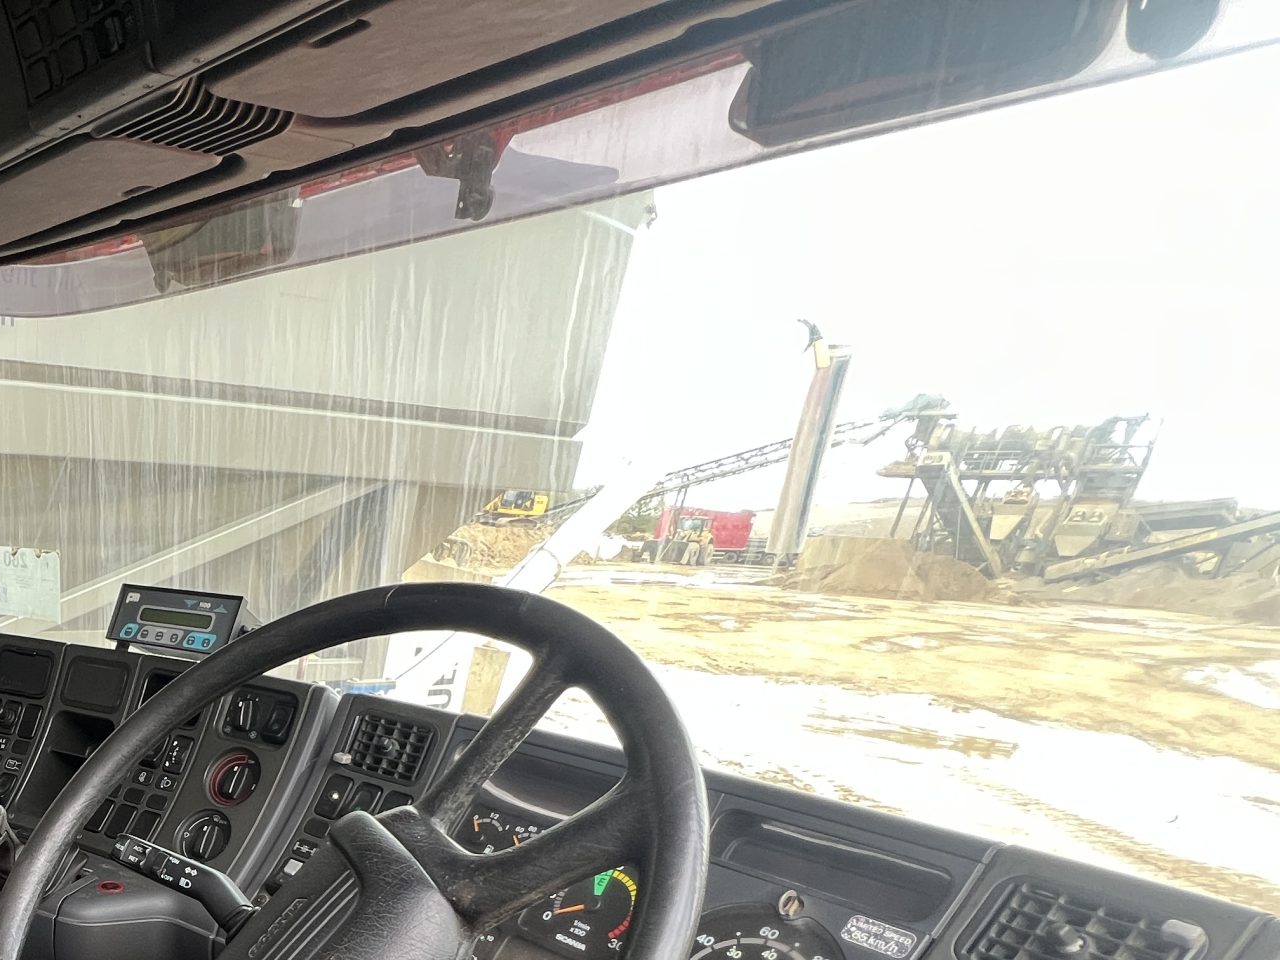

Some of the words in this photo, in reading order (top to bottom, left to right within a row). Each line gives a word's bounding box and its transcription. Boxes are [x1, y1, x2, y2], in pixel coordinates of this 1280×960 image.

[133, 845, 144, 853] ACC
[597, 877, 607, 887] E
[542, 910, 552, 921] 0
[759, 926, 780, 940] 60
[883, 930, 912, 945] SPEED
[555, 933, 586, 951] SCANIA
[696, 934, 715, 946] 40
[851, 930, 870, 941] 85
[867, 936, 899, 953] km/h
[726, 947, 742, 959] 30
[761, 951, 778, 960] 40
